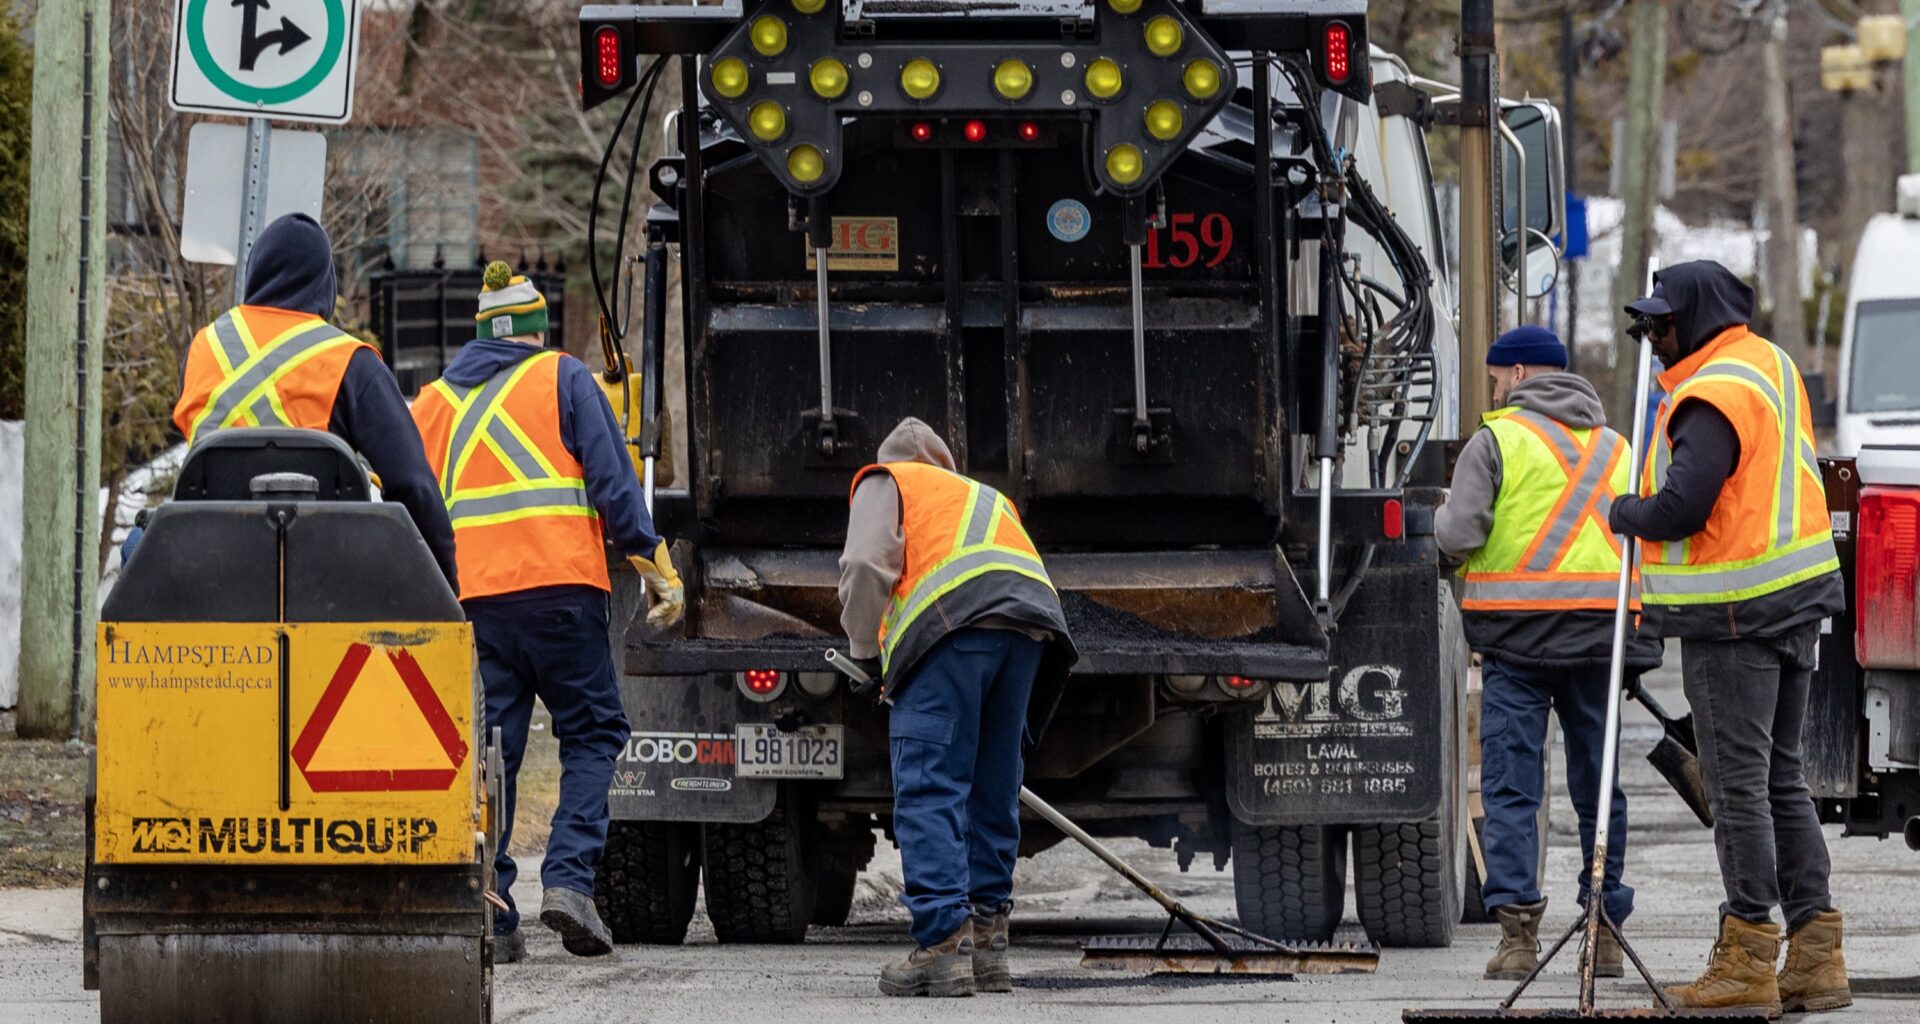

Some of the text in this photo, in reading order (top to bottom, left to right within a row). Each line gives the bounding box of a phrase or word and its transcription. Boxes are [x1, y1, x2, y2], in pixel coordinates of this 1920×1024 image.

[1141, 212, 1233, 268] 159
[108, 640, 273, 665] HAMPSTEAD
[108, 671, 273, 693] www.hampstead.qc.ca
[1254, 664, 1408, 722] MG
[616, 738, 736, 765] LOBOCA
[741, 738, 838, 765] L981023
[1306, 743, 1359, 760] LAVAL
[608, 788, 655, 796] ESTERN STAR
[676, 780, 726, 789] FREIGHTLINER
[200, 817, 438, 854] MULTIQUIP
